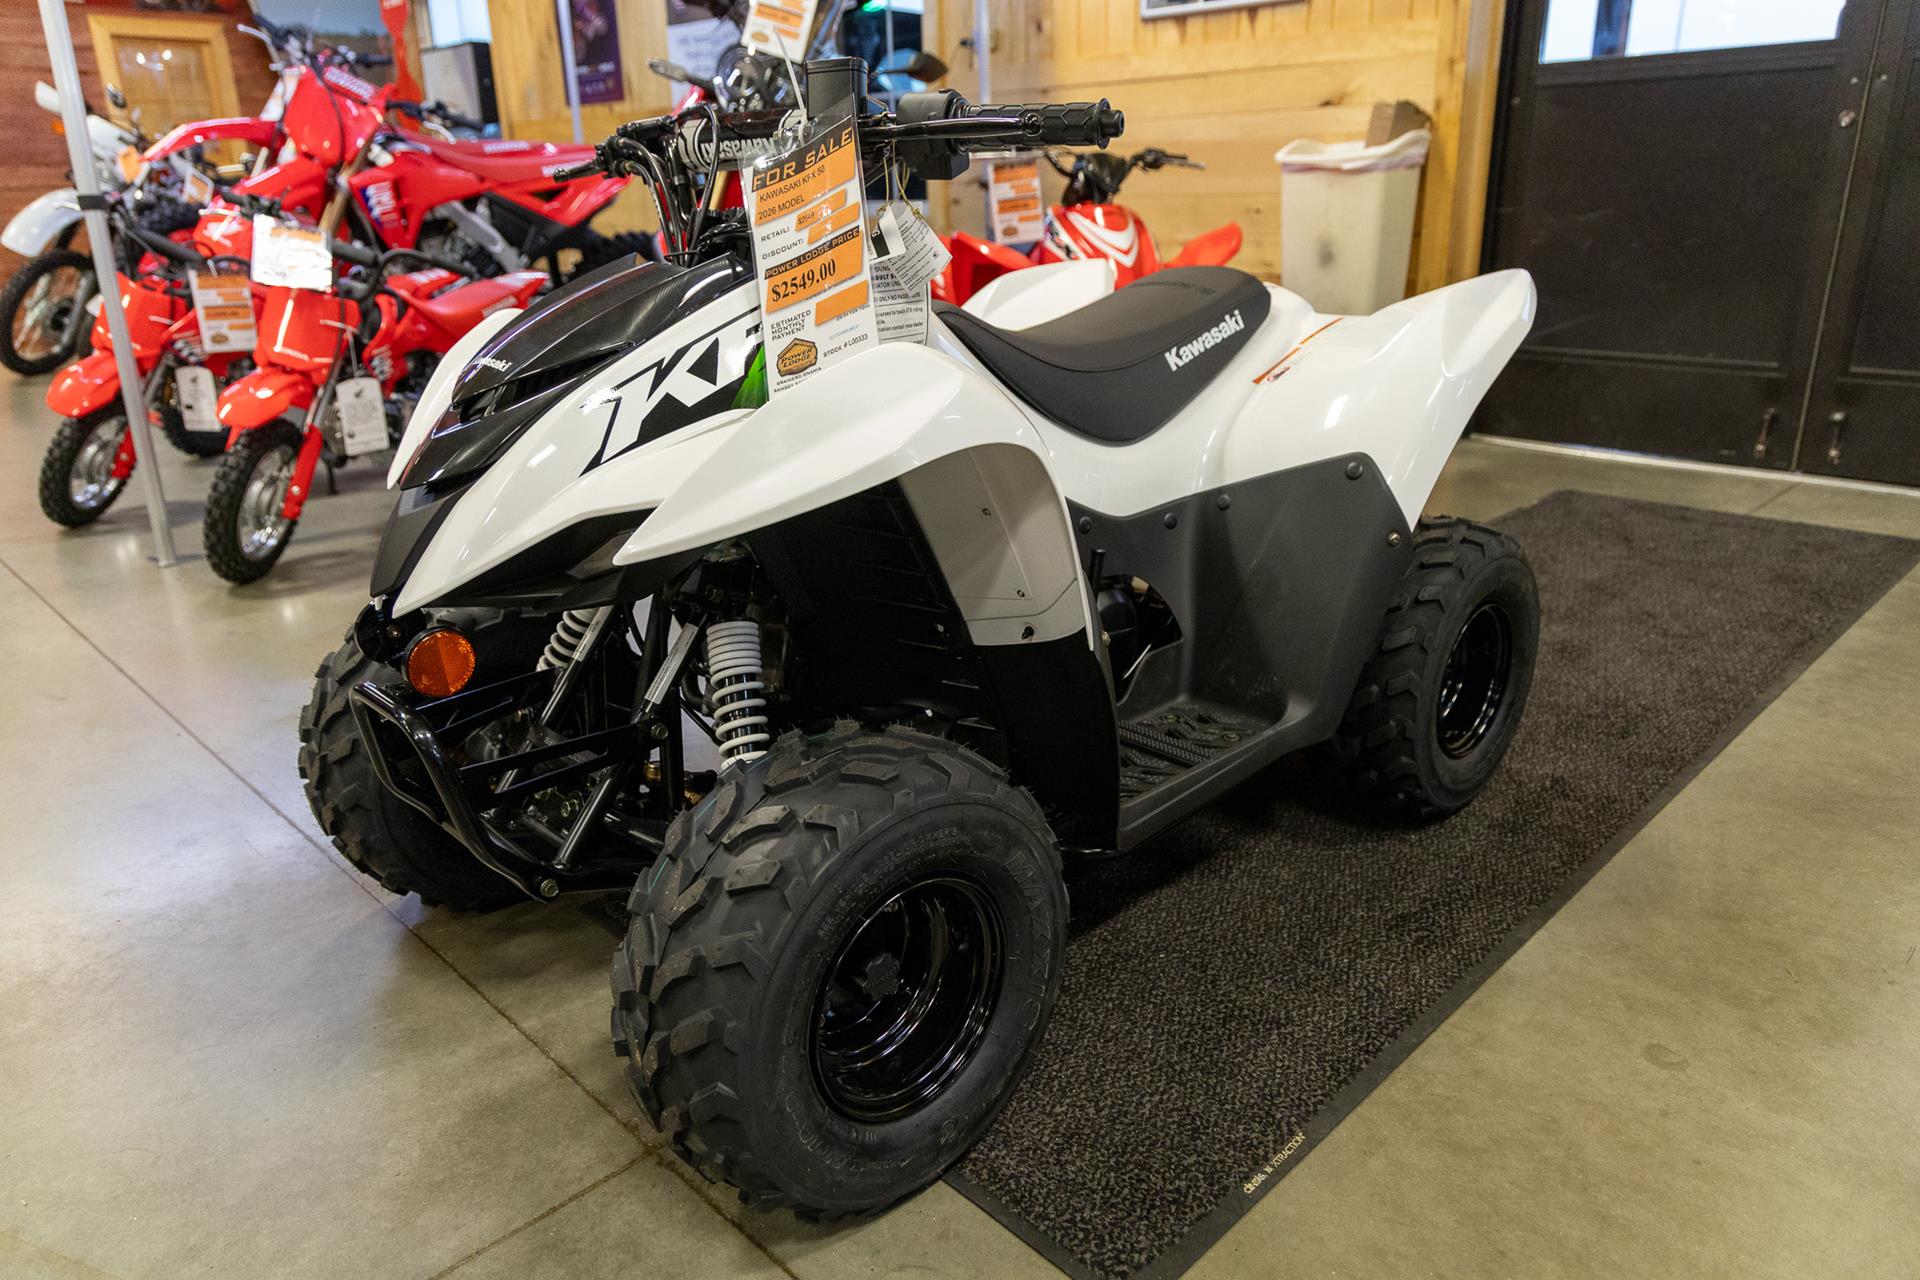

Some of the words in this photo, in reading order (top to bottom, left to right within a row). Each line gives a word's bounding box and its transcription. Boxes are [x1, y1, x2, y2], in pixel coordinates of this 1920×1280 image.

[753, 162, 796, 191] FOR
[804, 127, 854, 169] SALE
[759, 180, 801, 202] KAWASAKI
[802, 171, 817, 185] KFX
[816, 165, 825, 176] 50
[758, 206, 776, 220] 2026
[778, 194, 805, 213] MODEL
[760, 227, 790, 243] RETAIL:
[762, 239, 805, 260] DISCOUNT:
[765, 260, 799, 278] POWER
[801, 242, 831, 264] LODGE
[832, 228, 860, 249] PRICE
[771, 258, 836, 303] $2549.00
[771, 309, 811, 329] ESTIMATED
[771, 318, 806, 335] MONTHLY
[771, 325, 805, 341] PAYMENT
[1164, 309, 1245, 371] Kawasaki
[781, 347, 813, 363] POWER
[782, 354, 811, 368] LODGE
[823, 346, 842, 357] STOCK
